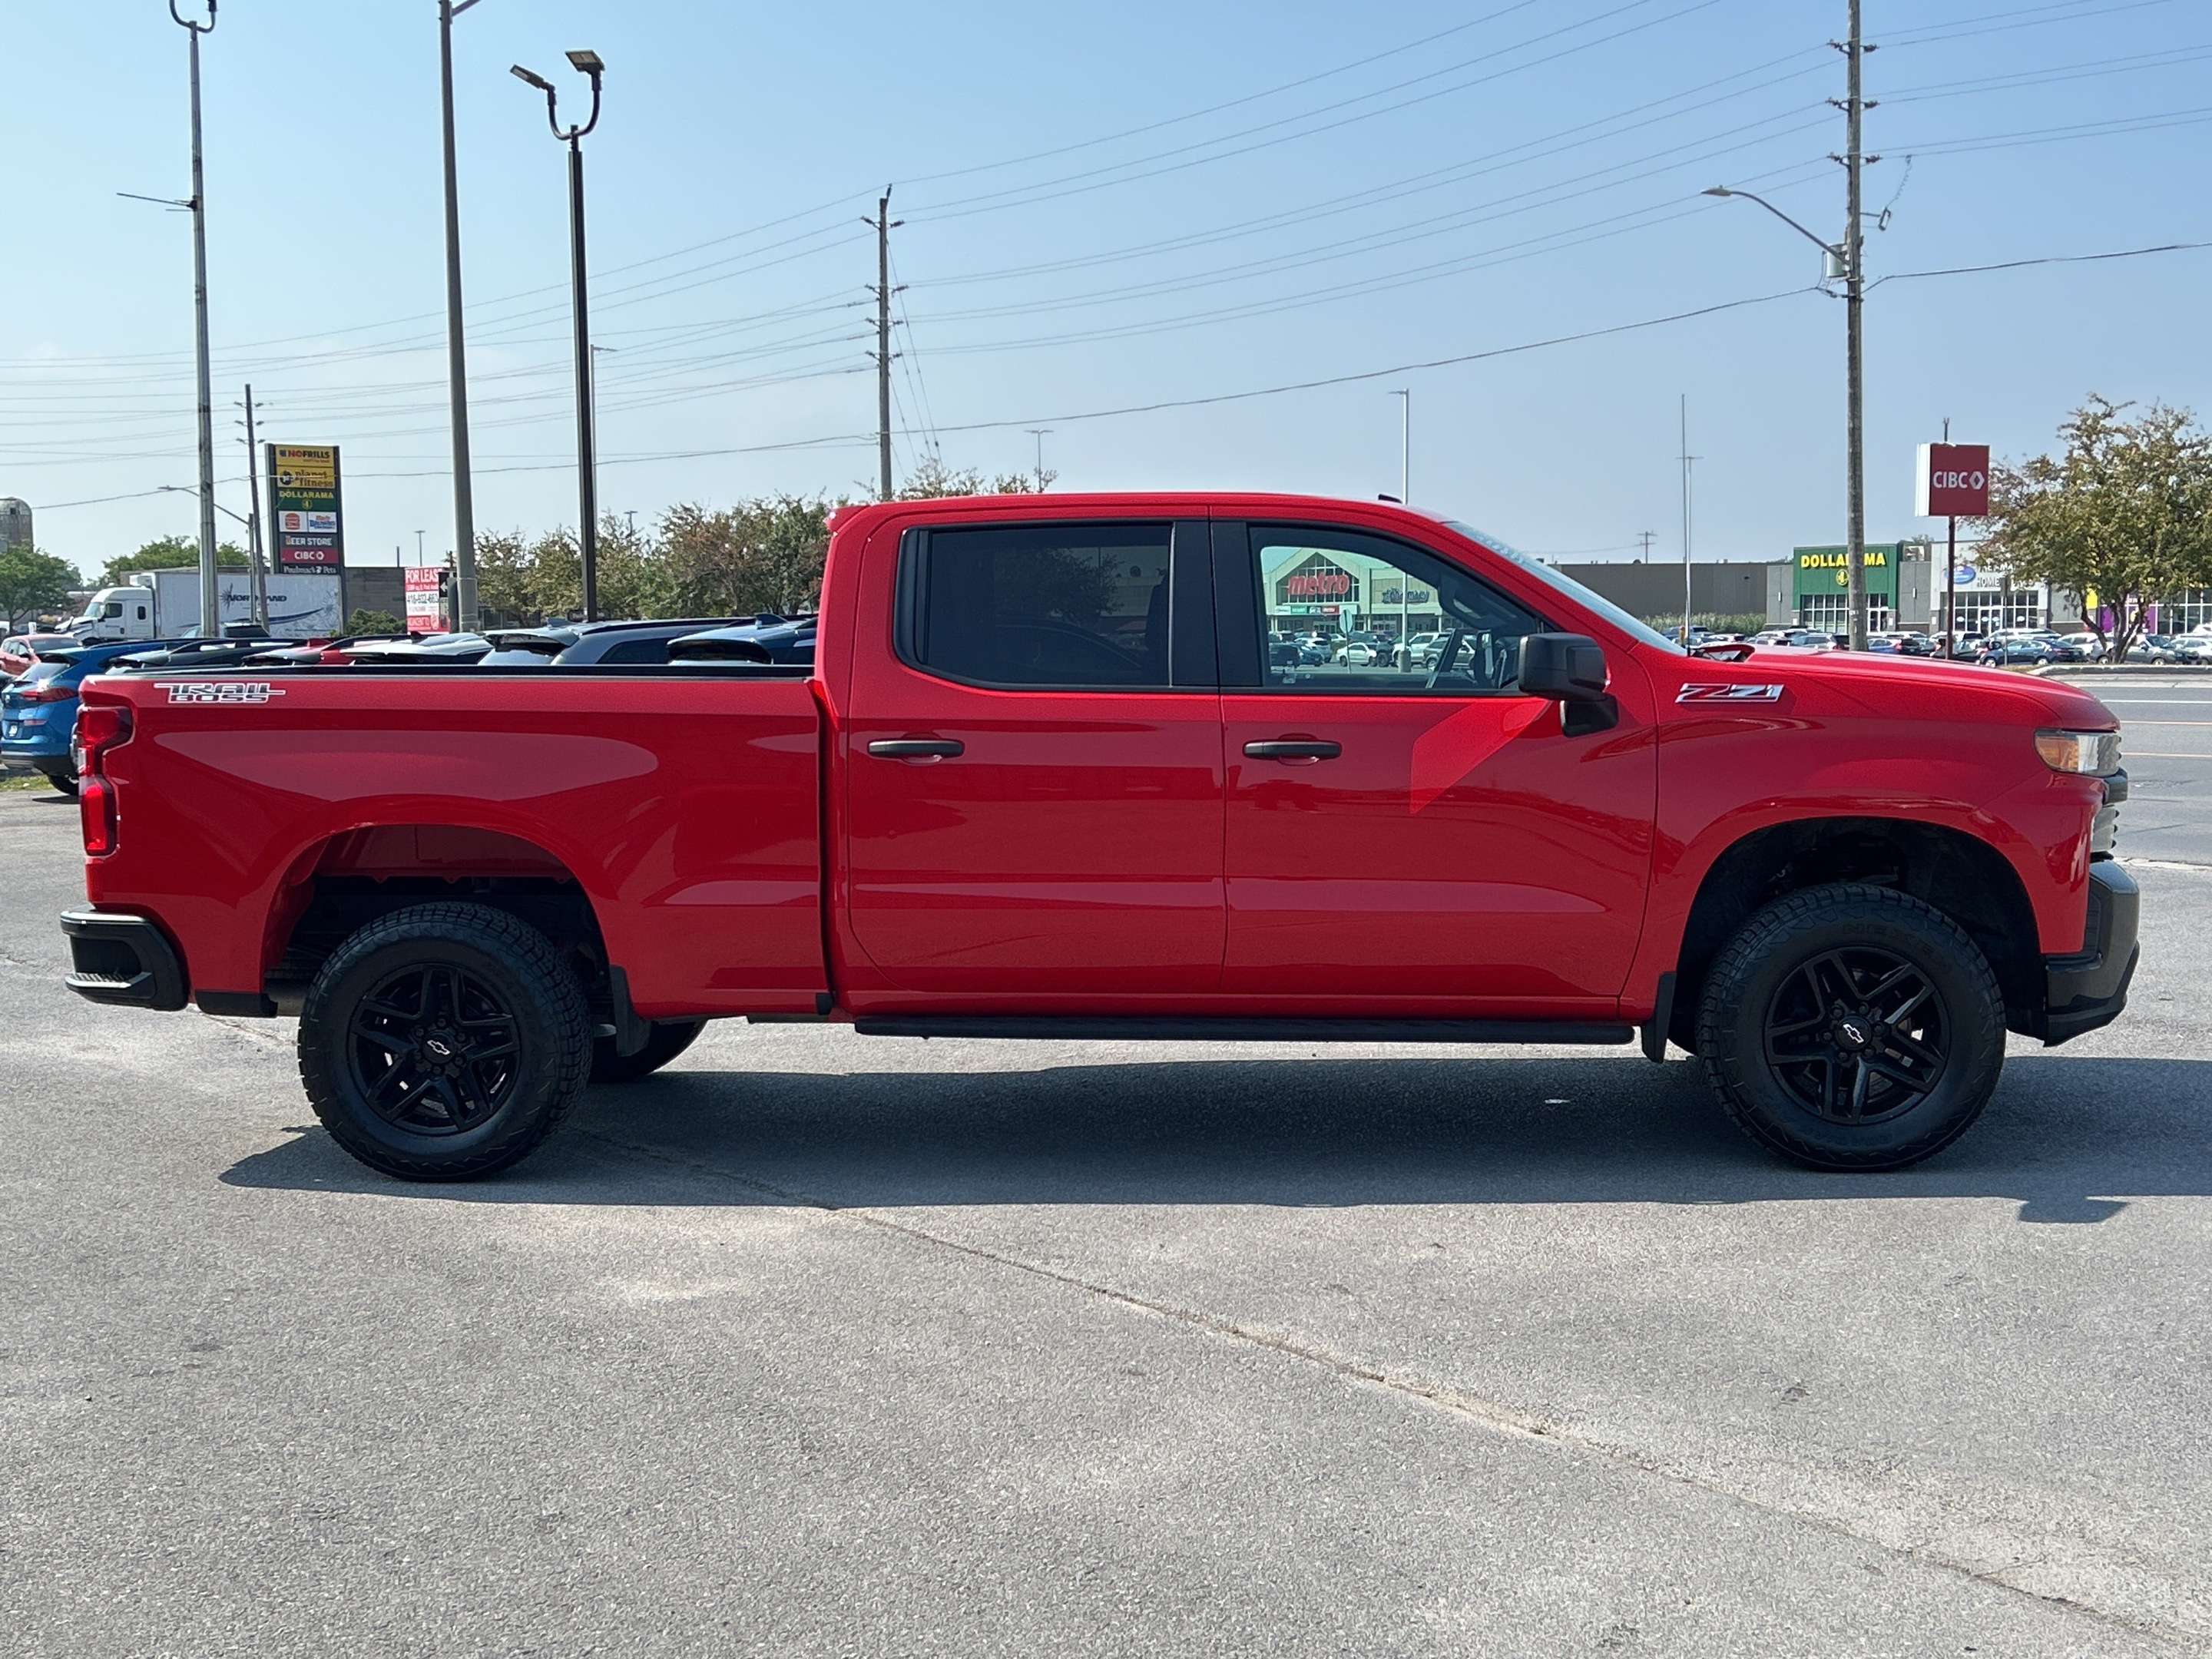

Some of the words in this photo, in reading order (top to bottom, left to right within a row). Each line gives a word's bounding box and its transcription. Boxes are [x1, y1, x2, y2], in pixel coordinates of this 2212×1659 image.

[1932, 471, 1969, 488] CIBC
[307, 537, 333, 546] STORE
[294, 551, 315, 560] CIBC
[1800, 552, 1886, 568] DOLLAMA
[406, 569, 421, 583] FOR
[421, 568, 442, 583] LEAS
[1288, 571, 1349, 594] metro
[154, 683, 286, 694] TRAIL
[1675, 683, 1785, 703] Z71
[167, 693, 270, 704] BOSS
